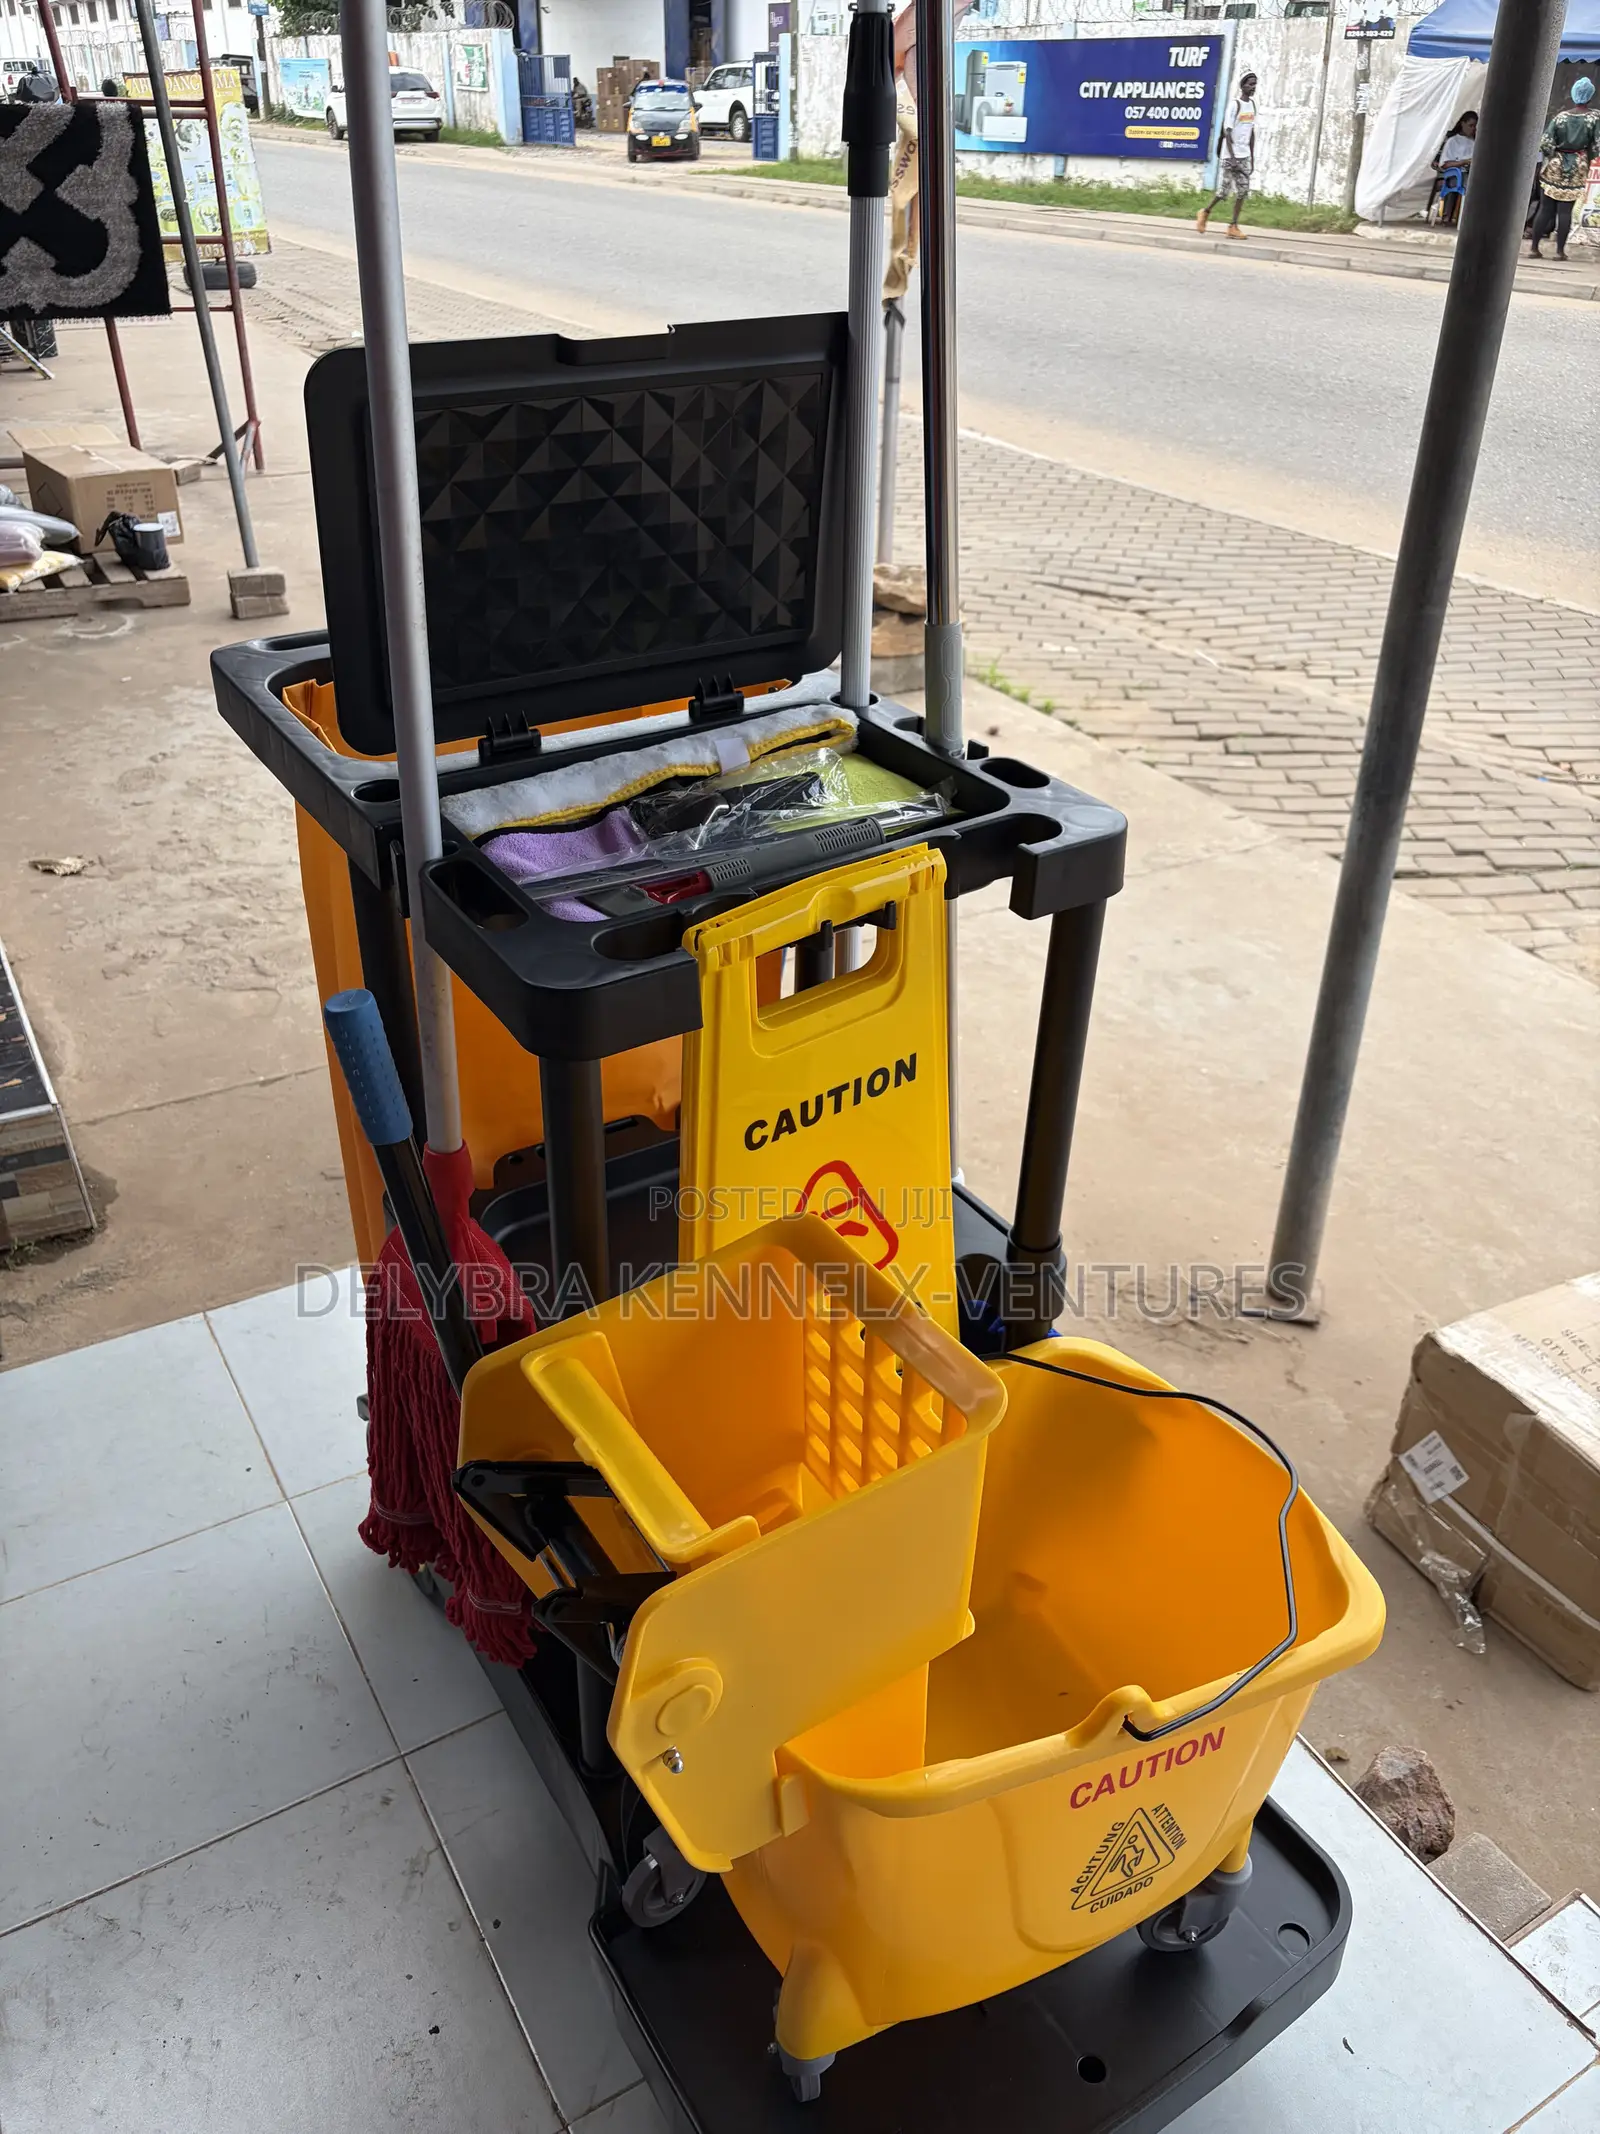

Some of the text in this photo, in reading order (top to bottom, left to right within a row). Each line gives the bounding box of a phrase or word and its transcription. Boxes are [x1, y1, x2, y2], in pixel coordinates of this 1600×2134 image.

[1168, 46, 1210, 67] TURF
[1079, 82, 1205, 99] CITY APPLIANCES
[1124, 106, 1202, 120] 057 400 0000
[744, 1053, 917, 1151] CAUTION
[1070, 1727, 1225, 1809] CAUTION
[1151, 1803, 1188, 1850] ATTENTION
[1070, 1821, 1124, 1894] ACHTUNG
[1090, 1876, 1154, 1913] CUIDADO
